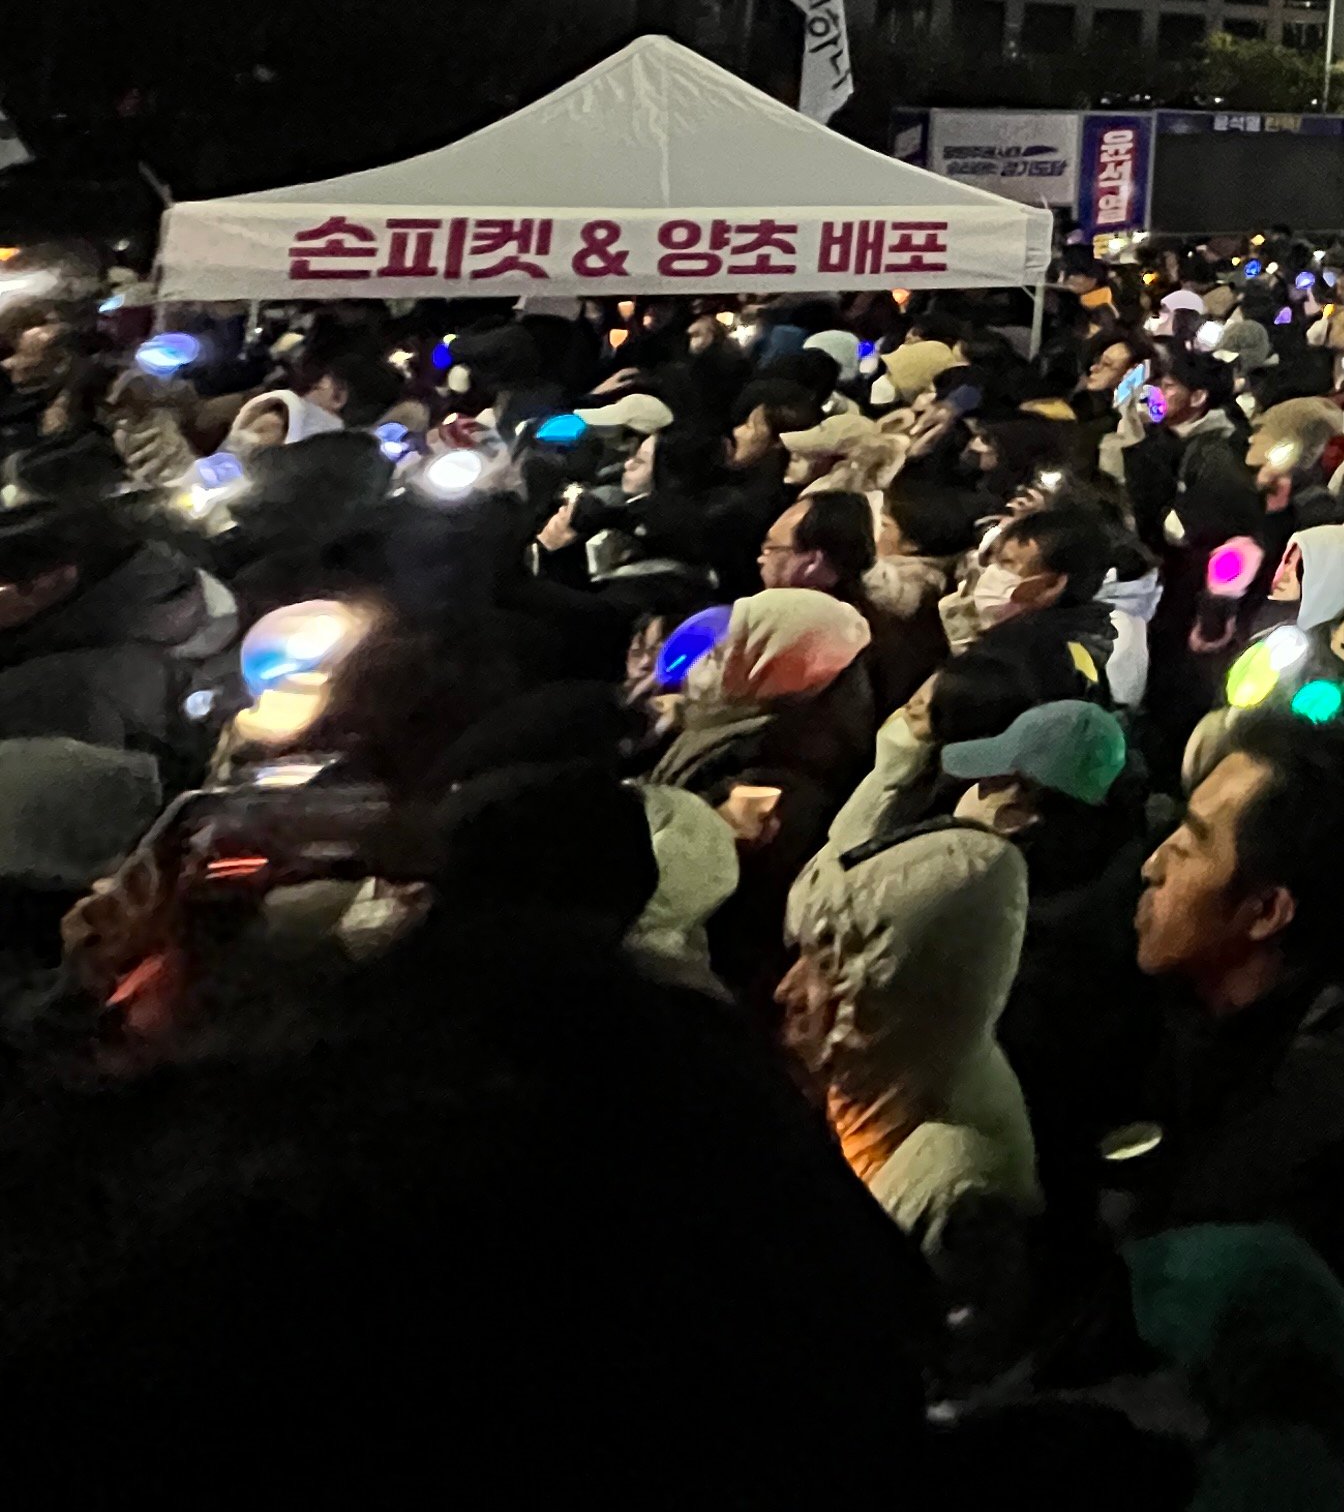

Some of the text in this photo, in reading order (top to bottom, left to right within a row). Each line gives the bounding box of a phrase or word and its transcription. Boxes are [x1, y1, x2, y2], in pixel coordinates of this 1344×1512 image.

[290, 216, 946, 279] 손피켓 & 양초 배포
